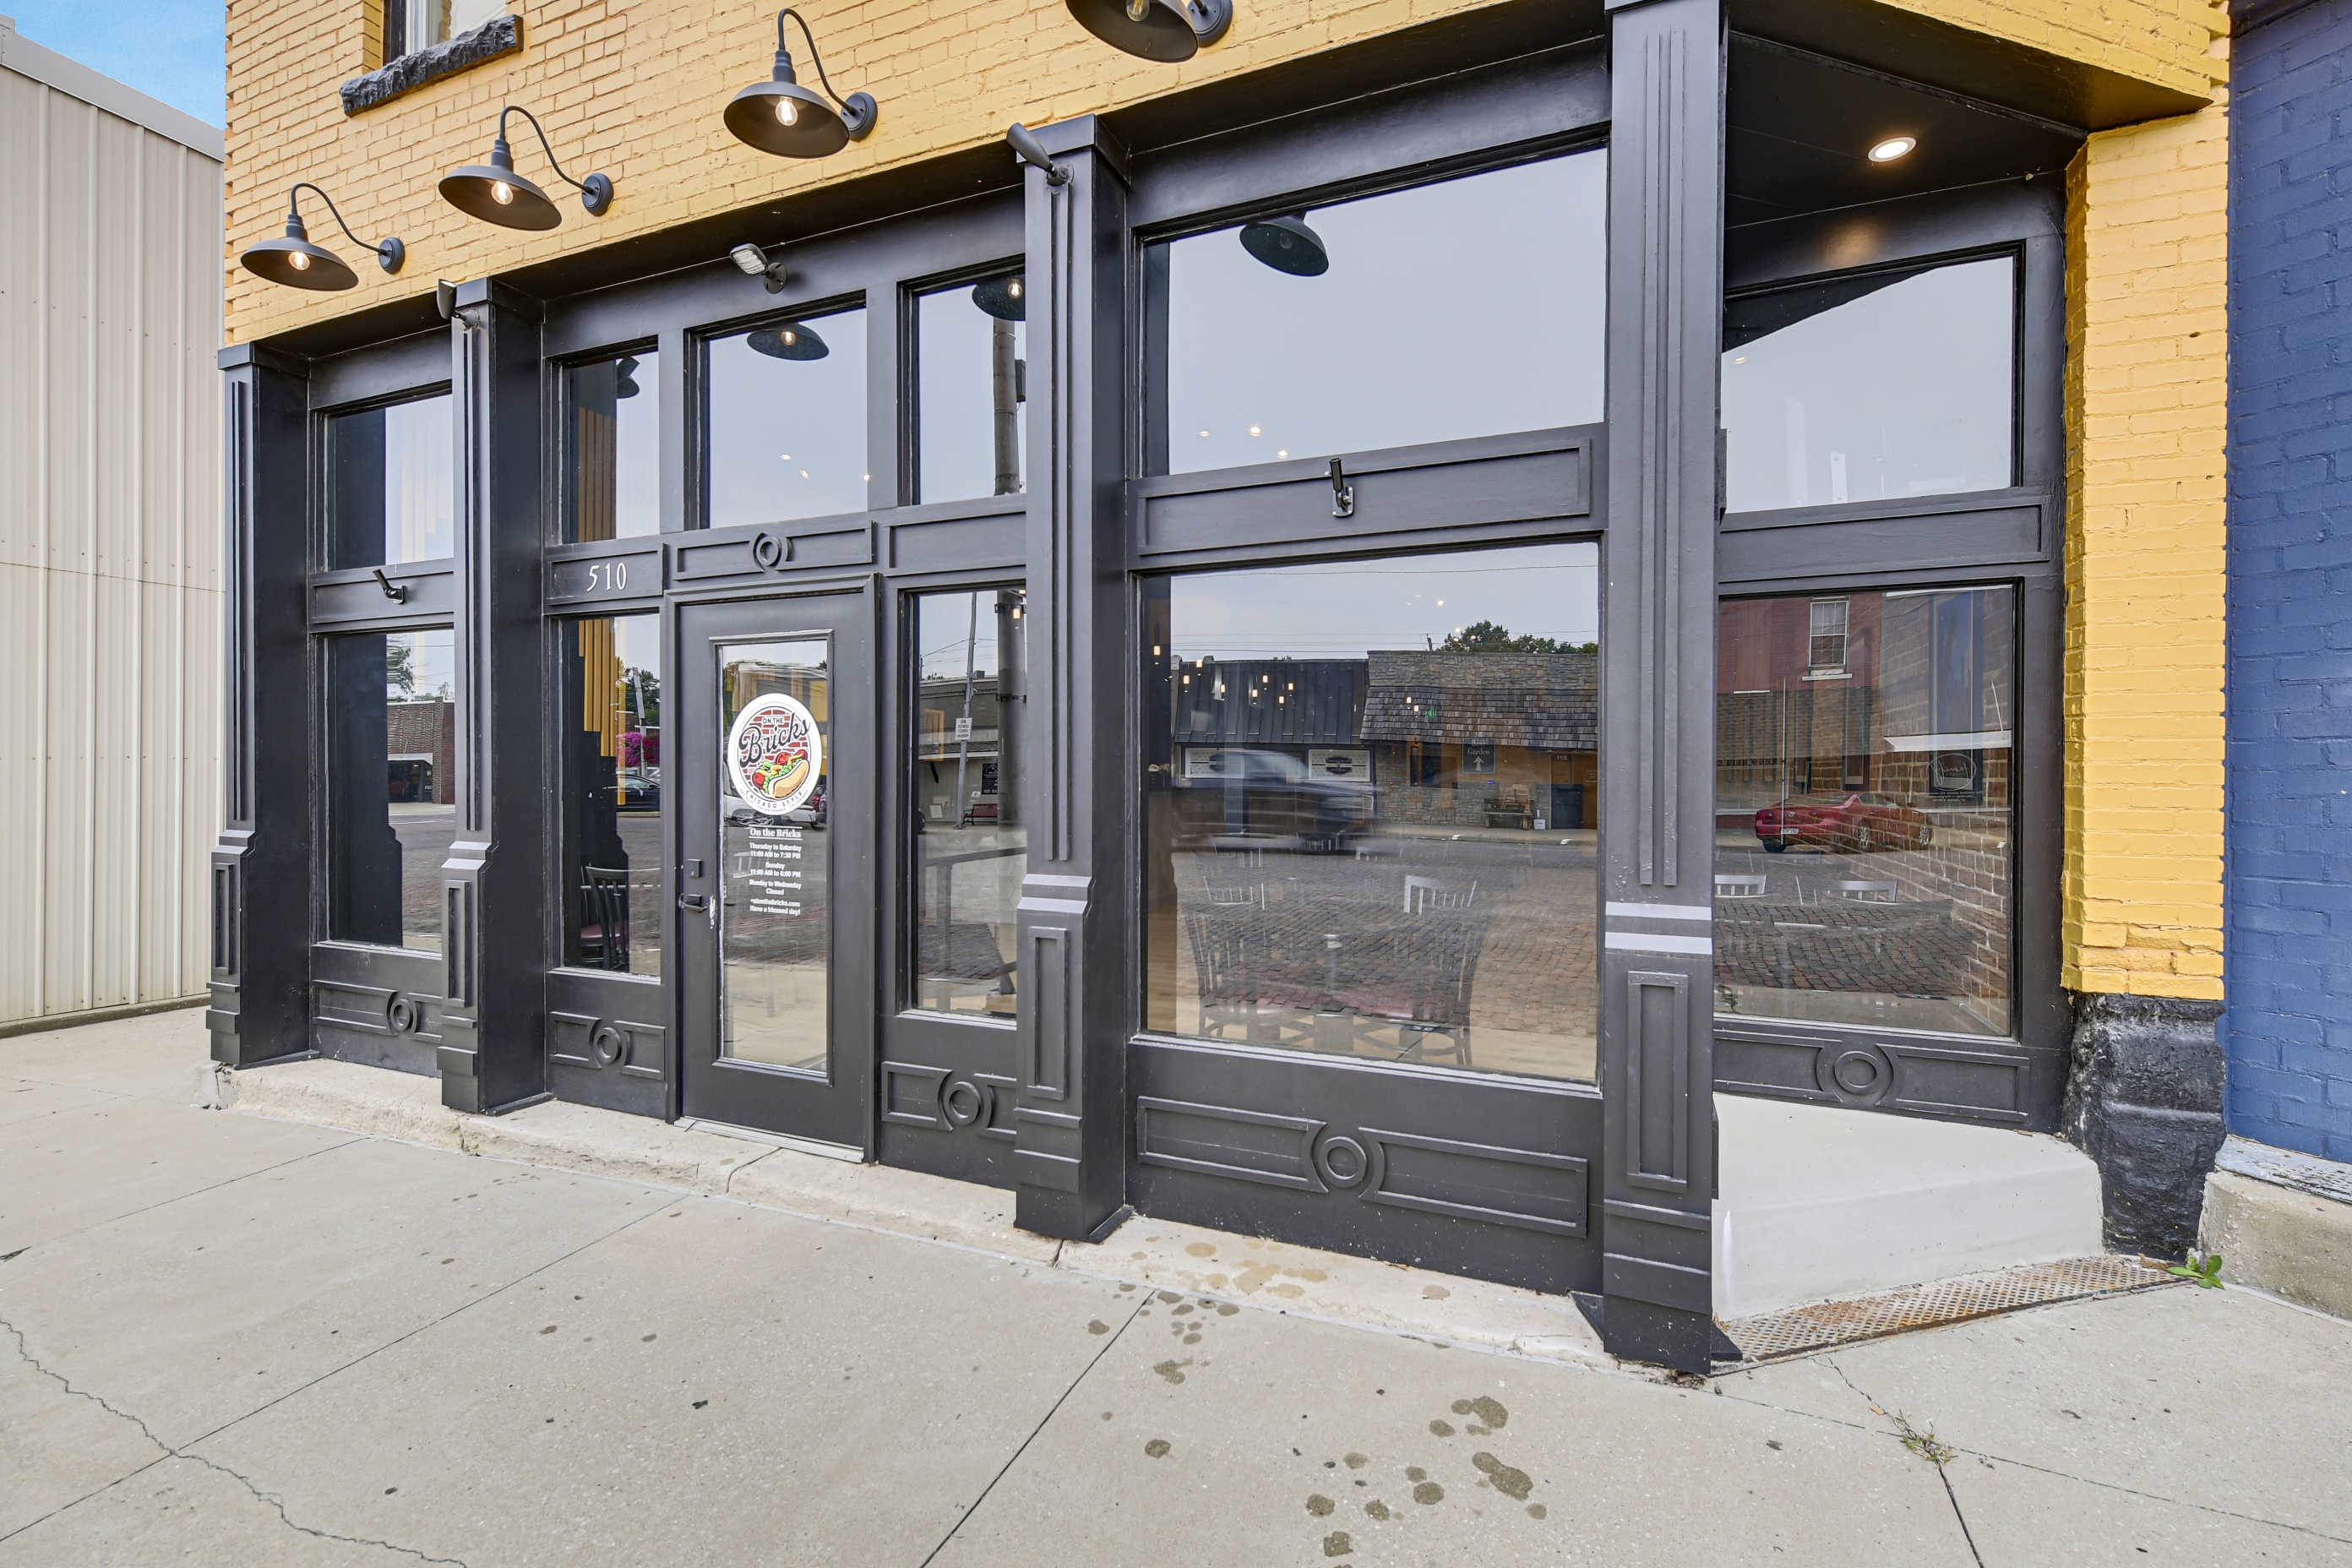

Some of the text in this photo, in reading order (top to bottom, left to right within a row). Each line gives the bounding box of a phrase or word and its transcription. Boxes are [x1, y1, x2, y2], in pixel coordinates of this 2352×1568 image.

[586, 562, 627, 592] 510
[738, 711, 811, 768] Bricks
[746, 790, 803, 808] CHICAGO STYLE
[763, 828, 775, 836] the
[776, 829, 801, 837] Bricks
[749, 842, 772, 851] Thursday
[780, 844, 802, 852] Saturday
[765, 862, 785, 870] Sunday
[774, 880, 802, 890] Wednesday
